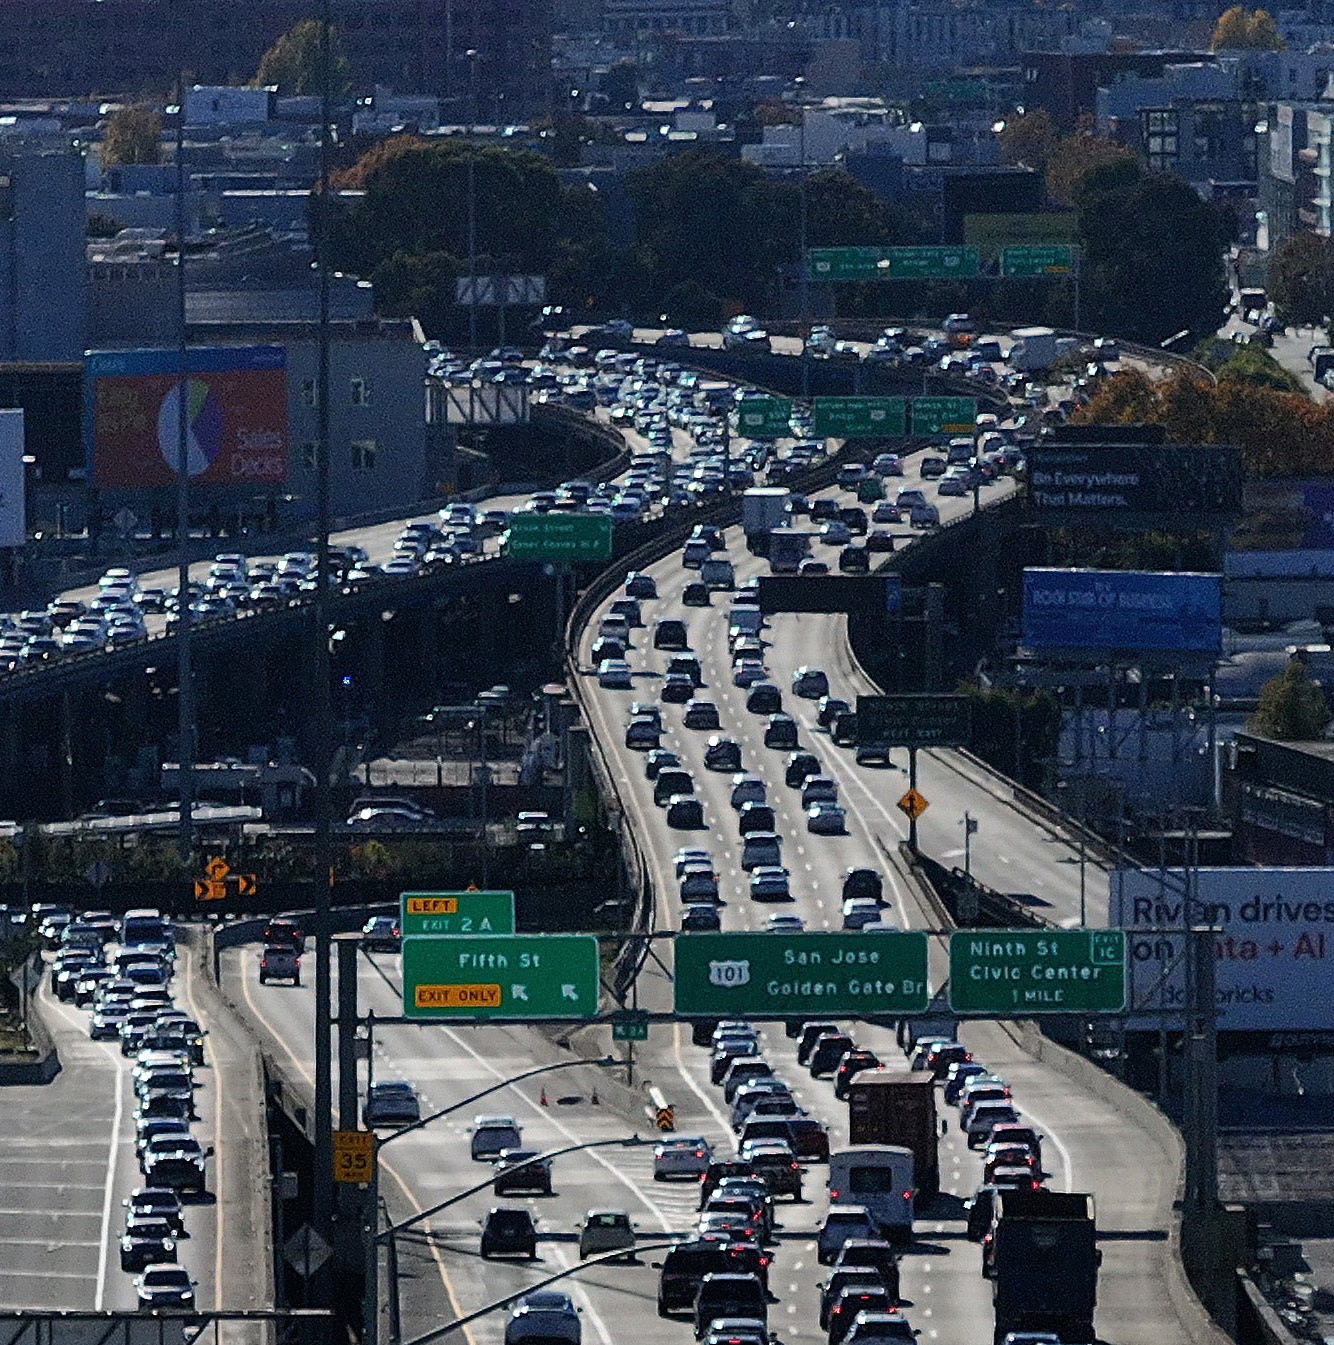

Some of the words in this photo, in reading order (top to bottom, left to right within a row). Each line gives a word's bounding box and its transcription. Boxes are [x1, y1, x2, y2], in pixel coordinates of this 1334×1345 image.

[413, 900, 450, 912] LEFT
[422, 920, 449, 931] EXIT
[970, 941, 1027, 958] Ninth
[1035, 941, 1059, 958] St
[1133, 942, 1174, 961] on
[1294, 932, 1326, 958] AI
[459, 953, 508, 968] Fifth
[519, 953, 540, 968] St
[784, 949, 822, 965] San
[831, 949, 880, 965] Jose
[716, 965, 744, 982] 101
[970, 964, 1023, 981] Civic
[1031, 964, 1102, 981] Center
[418, 990, 449, 1001] EXIT
[458, 990, 497, 1001] ONLY
[767, 980, 837, 997] Golden
[847, 980, 895, 997] Gate
[902, 980, 924, 997] Br
[1024, 989, 1064, 1003] MILE
[341, 1153, 367, 1169] 35
